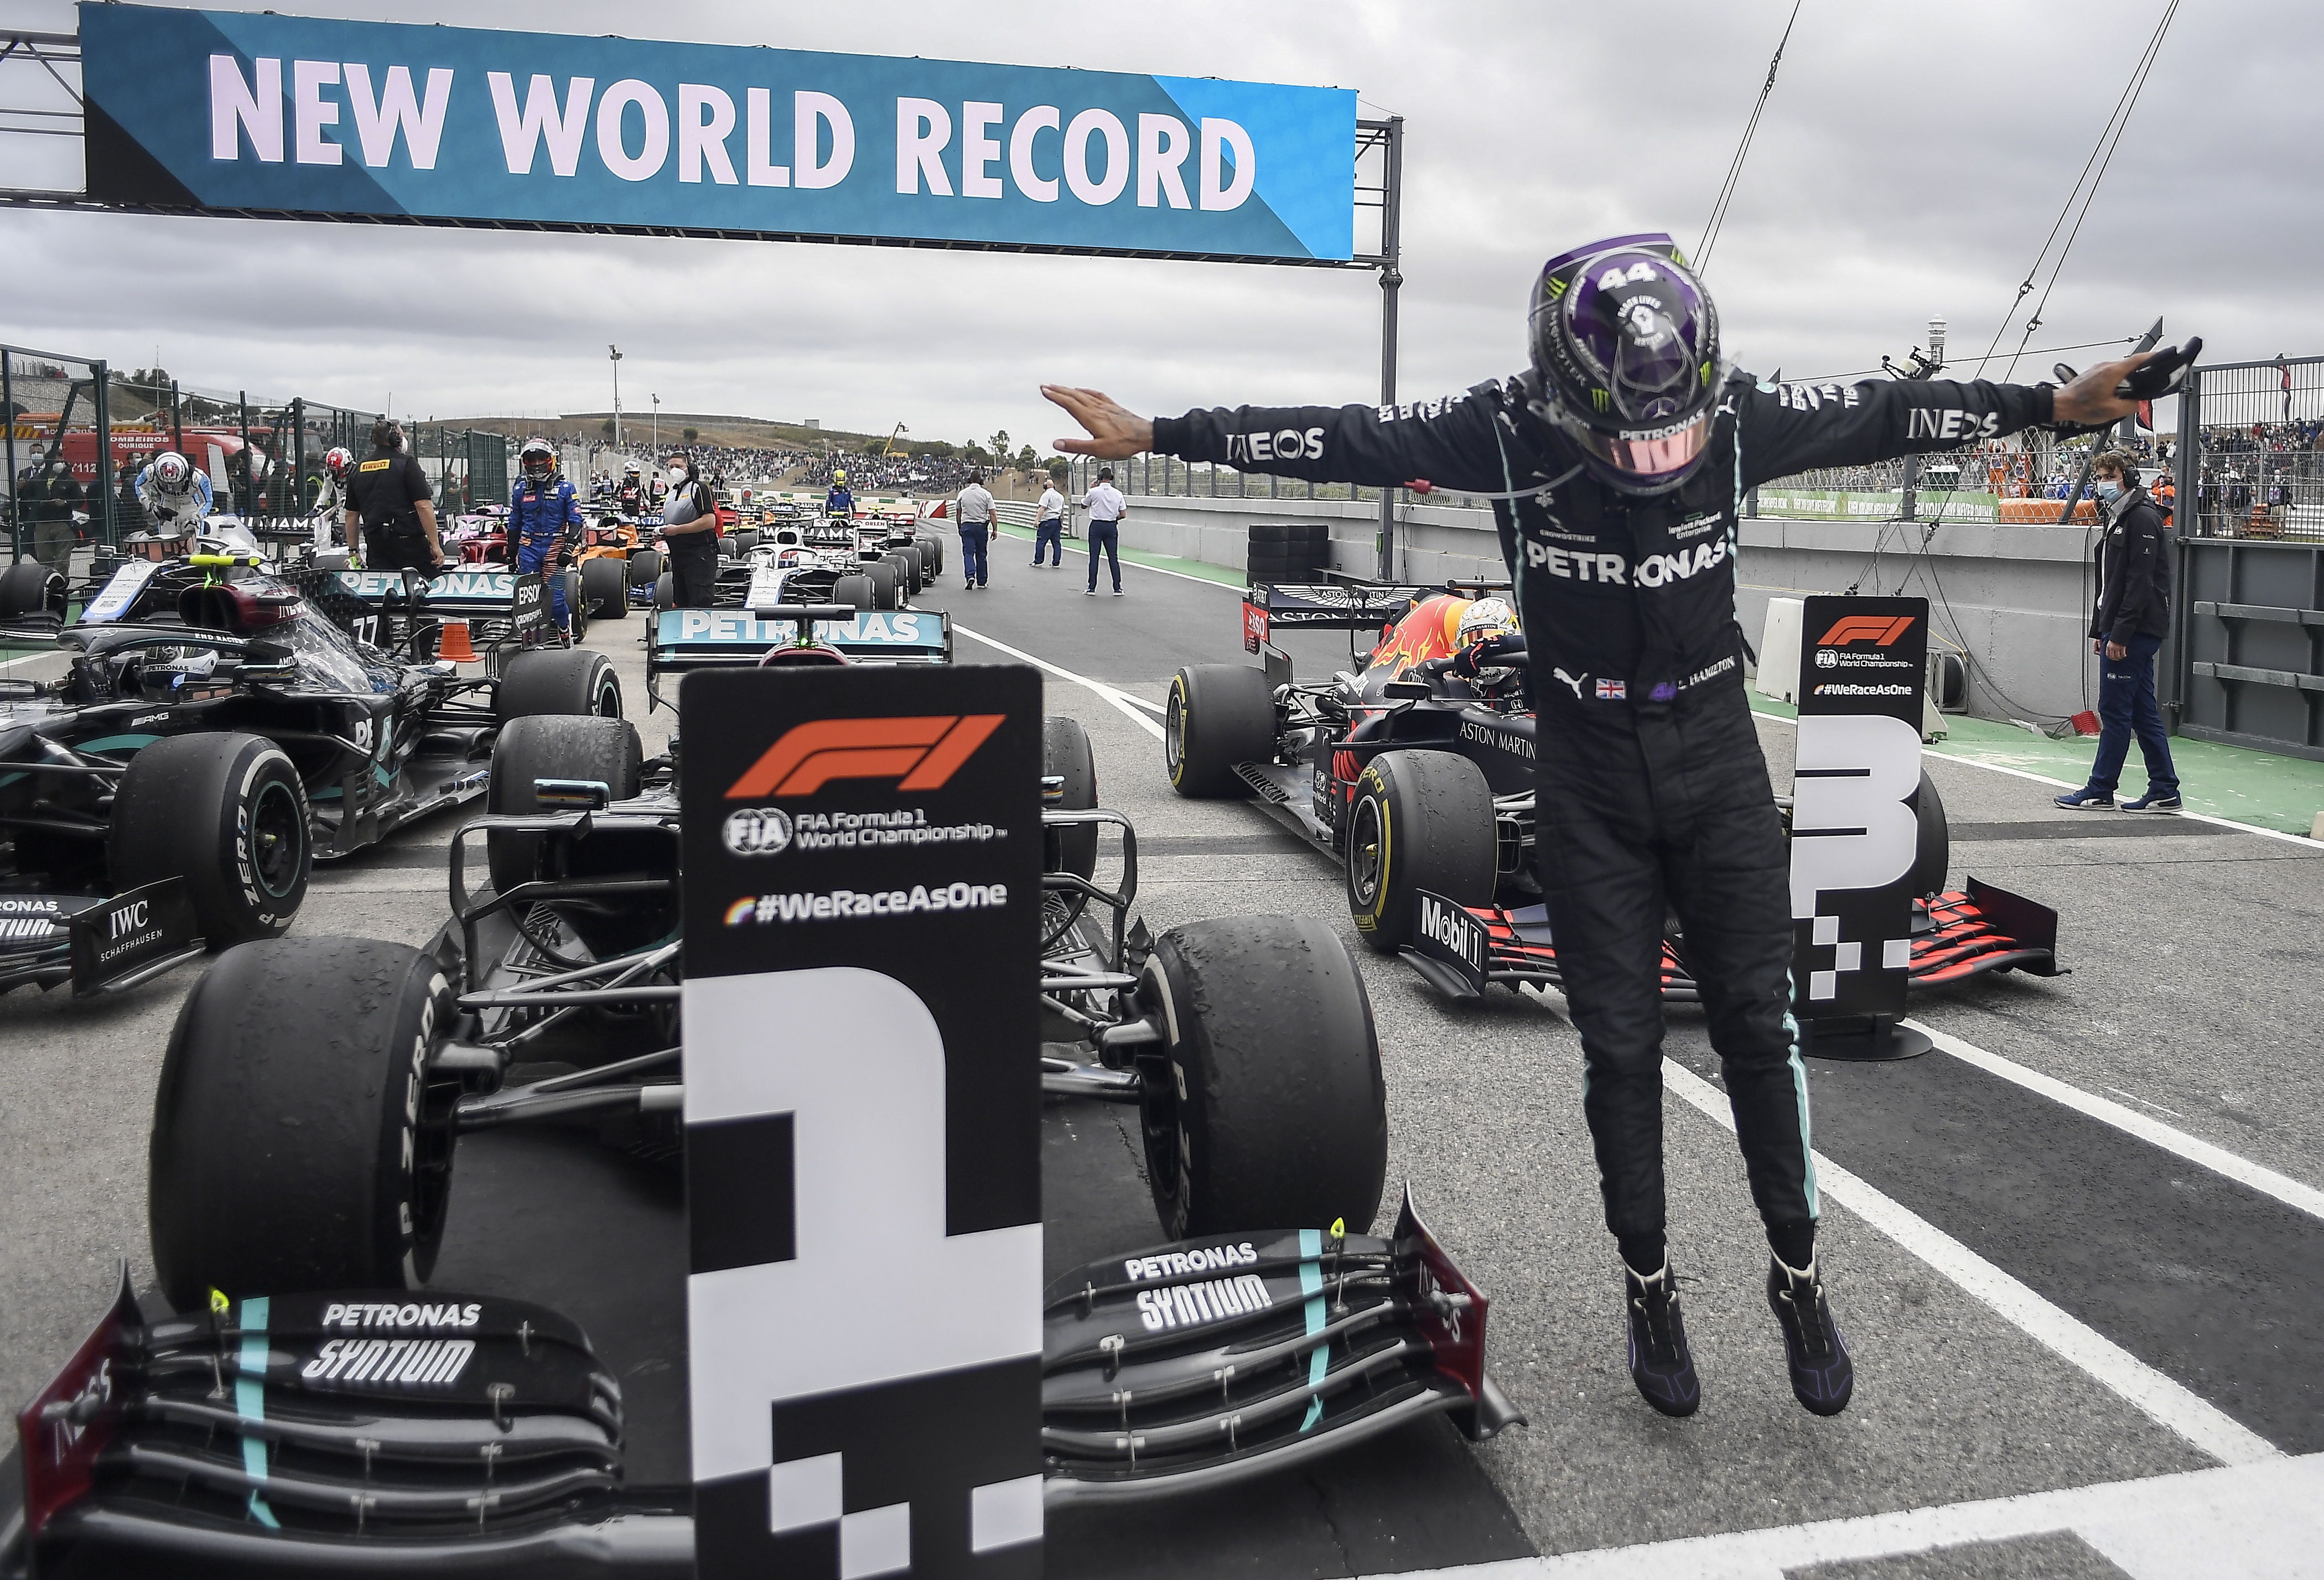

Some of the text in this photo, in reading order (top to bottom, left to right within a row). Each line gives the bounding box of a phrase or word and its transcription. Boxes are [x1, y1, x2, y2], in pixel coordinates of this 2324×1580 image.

[209, 53, 1256, 211] NEW WORLD RECORD
[1597, 262, 1657, 292] 44
[1619, 408, 1705, 440] PETRONAS
[1907, 407, 1999, 440] INEOS
[1226, 427, 1325, 464] INEOS
[1676, 525, 1712, 540] Enterprise
[1694, 511, 1722, 528] Packard
[1526, 534, 1727, 589] PETRONAS
[341, 572, 515, 595] PETONAS
[353, 614, 379, 646] 77
[1817, 615, 1916, 646] F1
[1689, 655, 1736, 686] HAMILTON
[1824, 684, 1912, 695] #WeRaceAsOne
[144, 712, 169, 723] AMG
[723, 713, 1008, 799] F1
[1459, 721, 1536, 761] ASTON MARTIN
[796, 813, 831, 830] FIA
[833, 810, 915, 829] Formula
[915, 808, 928, 824] 1
[1789, 715, 1922, 918] 3
[796, 830, 857, 849] World
[860, 822, 995, 845] Championship
[236, 804, 261, 907] ZERO
[0, 901, 58, 912] ONAS
[755, 881, 1008, 922] #WeRaceAsOne
[111, 899, 148, 940] IWC
[1422, 896, 1468, 960] Mobil
[100, 929, 163, 962] SCHAFFHAUSEN
[683, 966, 1044, 1481] 1
[1124, 1241, 1258, 1282] PETRONAS
[321, 1302, 483, 1328] PETRONAS
[1135, 1274, 1274, 1330] SYNTIUM
[299, 1338, 477, 1384] SYNTIUM
